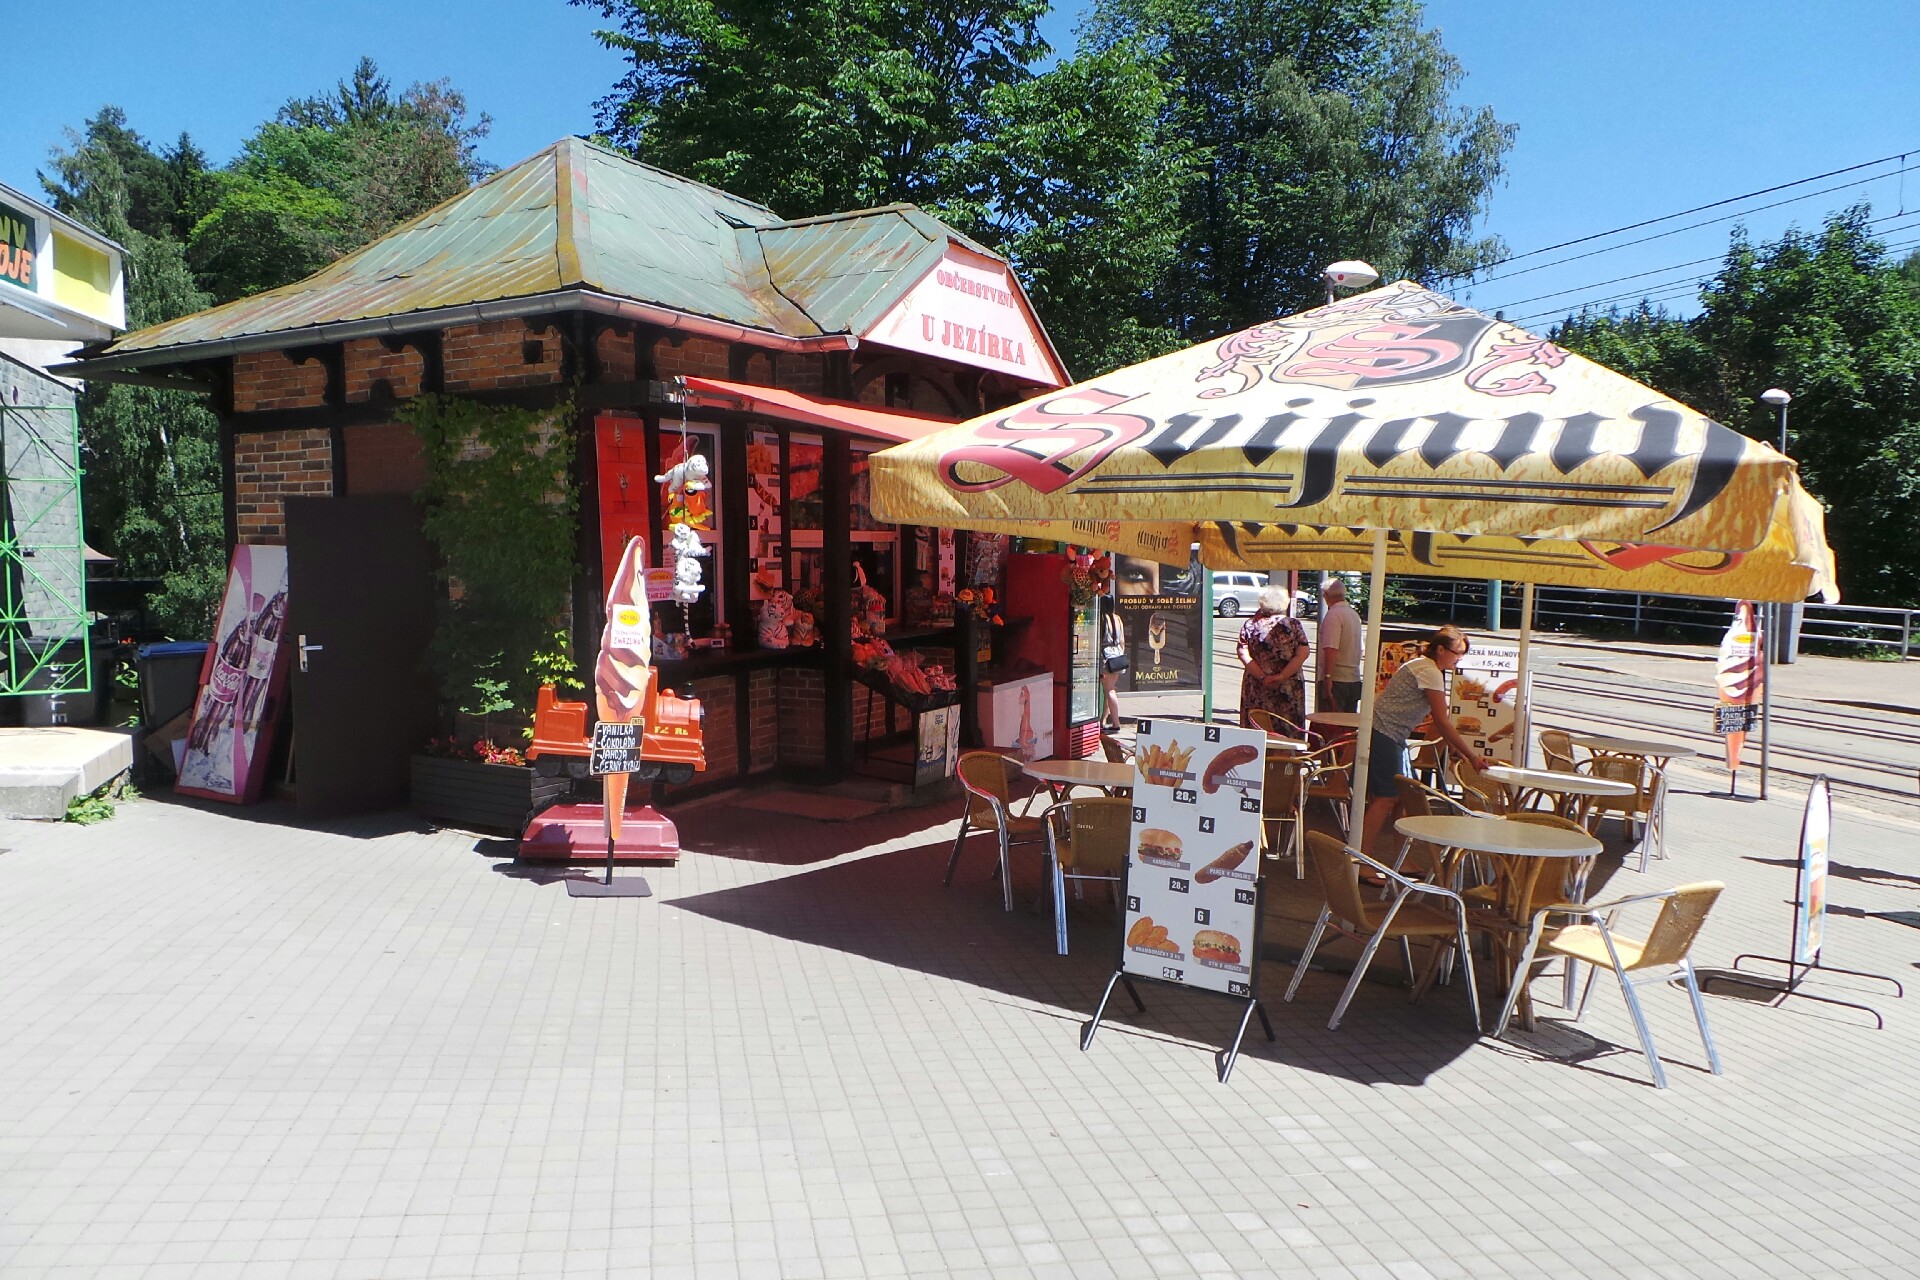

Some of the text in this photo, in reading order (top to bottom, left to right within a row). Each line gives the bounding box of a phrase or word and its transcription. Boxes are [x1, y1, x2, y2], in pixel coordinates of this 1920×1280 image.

[936, 268, 1015, 309] OBČERSTVENÍ
[921, 313, 1027, 366] U JEZÍRKA
[1135, 669, 1178, 681] MAGNUM
[1141, 721, 1147, 732] 1
[1208, 728, 1216, 740] 2
[1135, 809, 1142, 820] 3
[1202, 819, 1210, 831] 4
[1130, 898, 1136, 909] 5
[1197, 910, 1204, 922] 6
